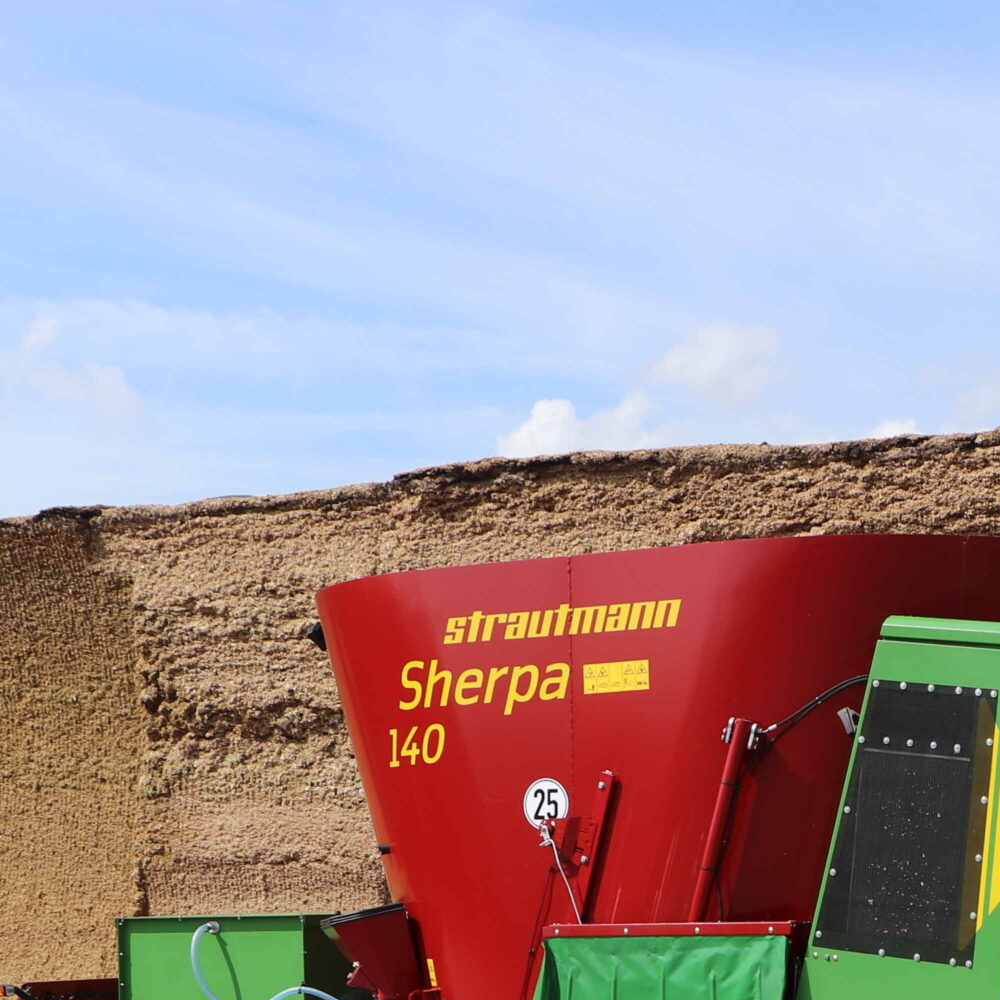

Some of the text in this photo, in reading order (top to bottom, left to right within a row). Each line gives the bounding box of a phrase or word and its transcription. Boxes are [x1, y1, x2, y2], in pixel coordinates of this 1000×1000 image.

[443, 599, 683, 645] strautmann
[398, 659, 570, 716] Sherpa
[388, 723, 446, 768] 140
[533, 788, 559, 820] 25
